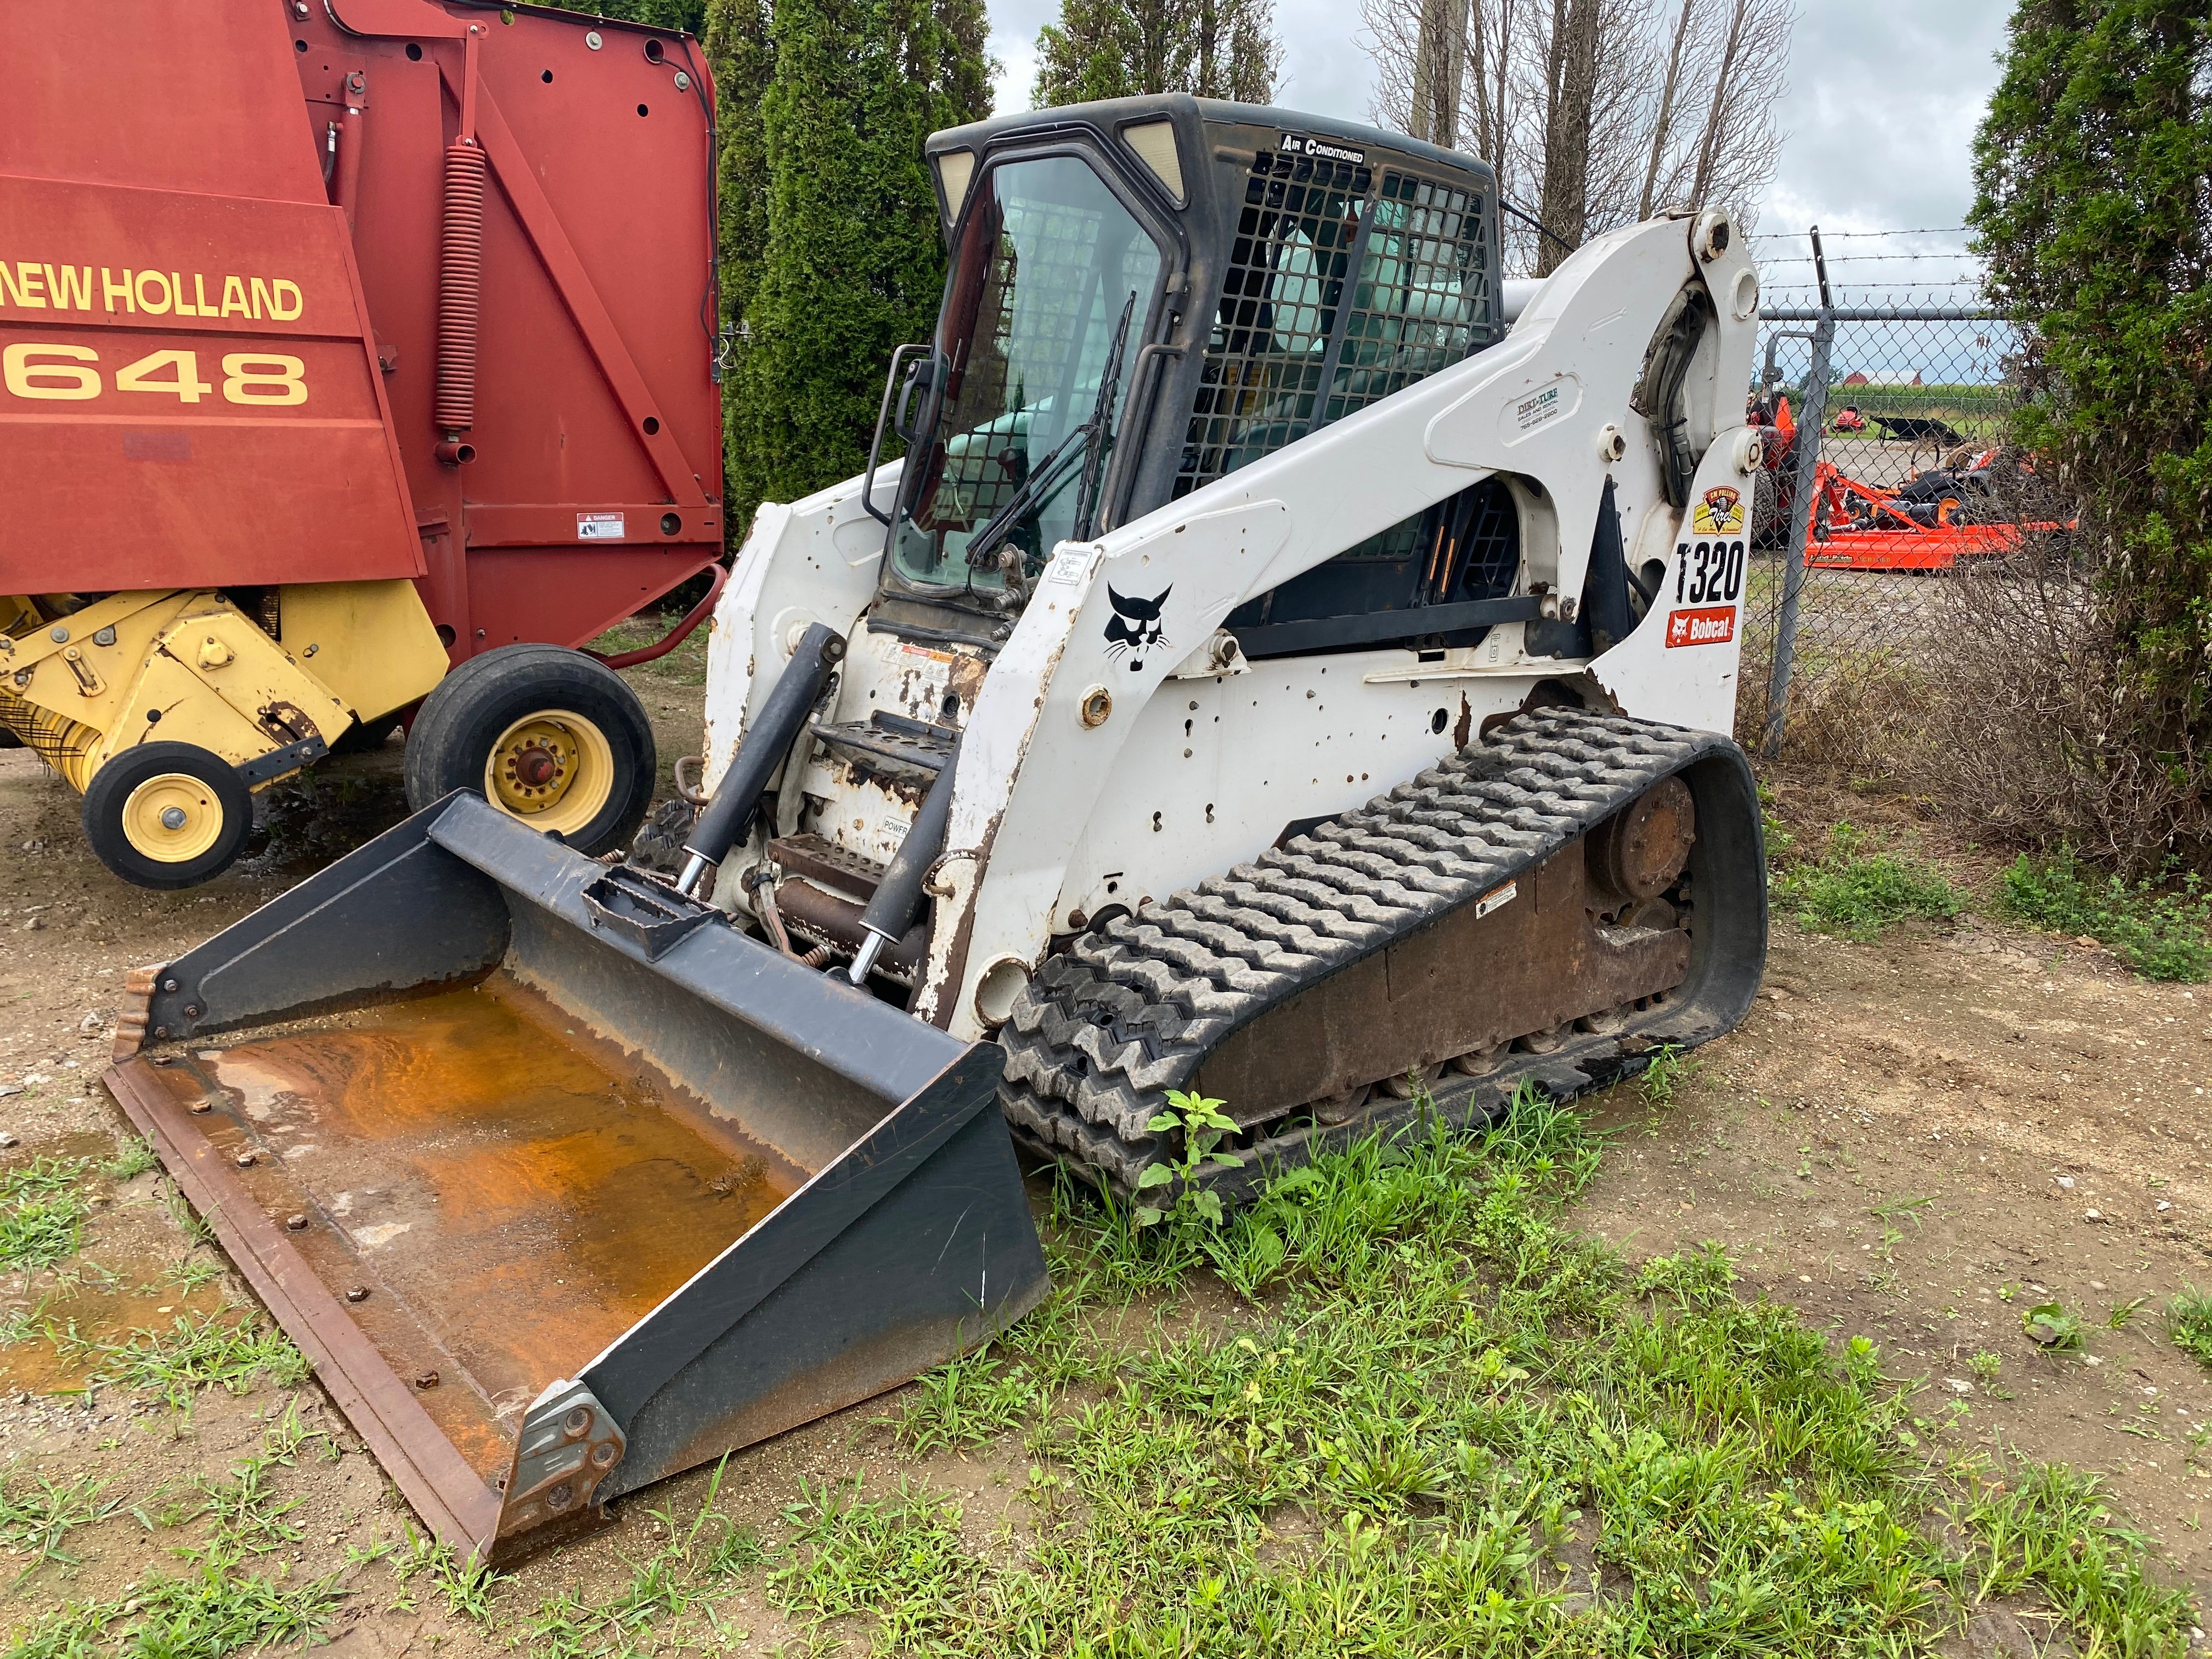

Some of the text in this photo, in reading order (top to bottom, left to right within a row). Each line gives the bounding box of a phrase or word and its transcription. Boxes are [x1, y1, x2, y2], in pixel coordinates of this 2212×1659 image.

[0, 261, 303, 321] NEW HOLLAND
[2, 342, 308, 406] 648
[1518, 412, 1532, 421] SALES
[1543, 399, 1558, 409] RENTAL
[1708, 507, 1733, 527] Tires
[1676, 540, 1744, 604] T320
[1690, 616, 1729, 640] Bobcat
